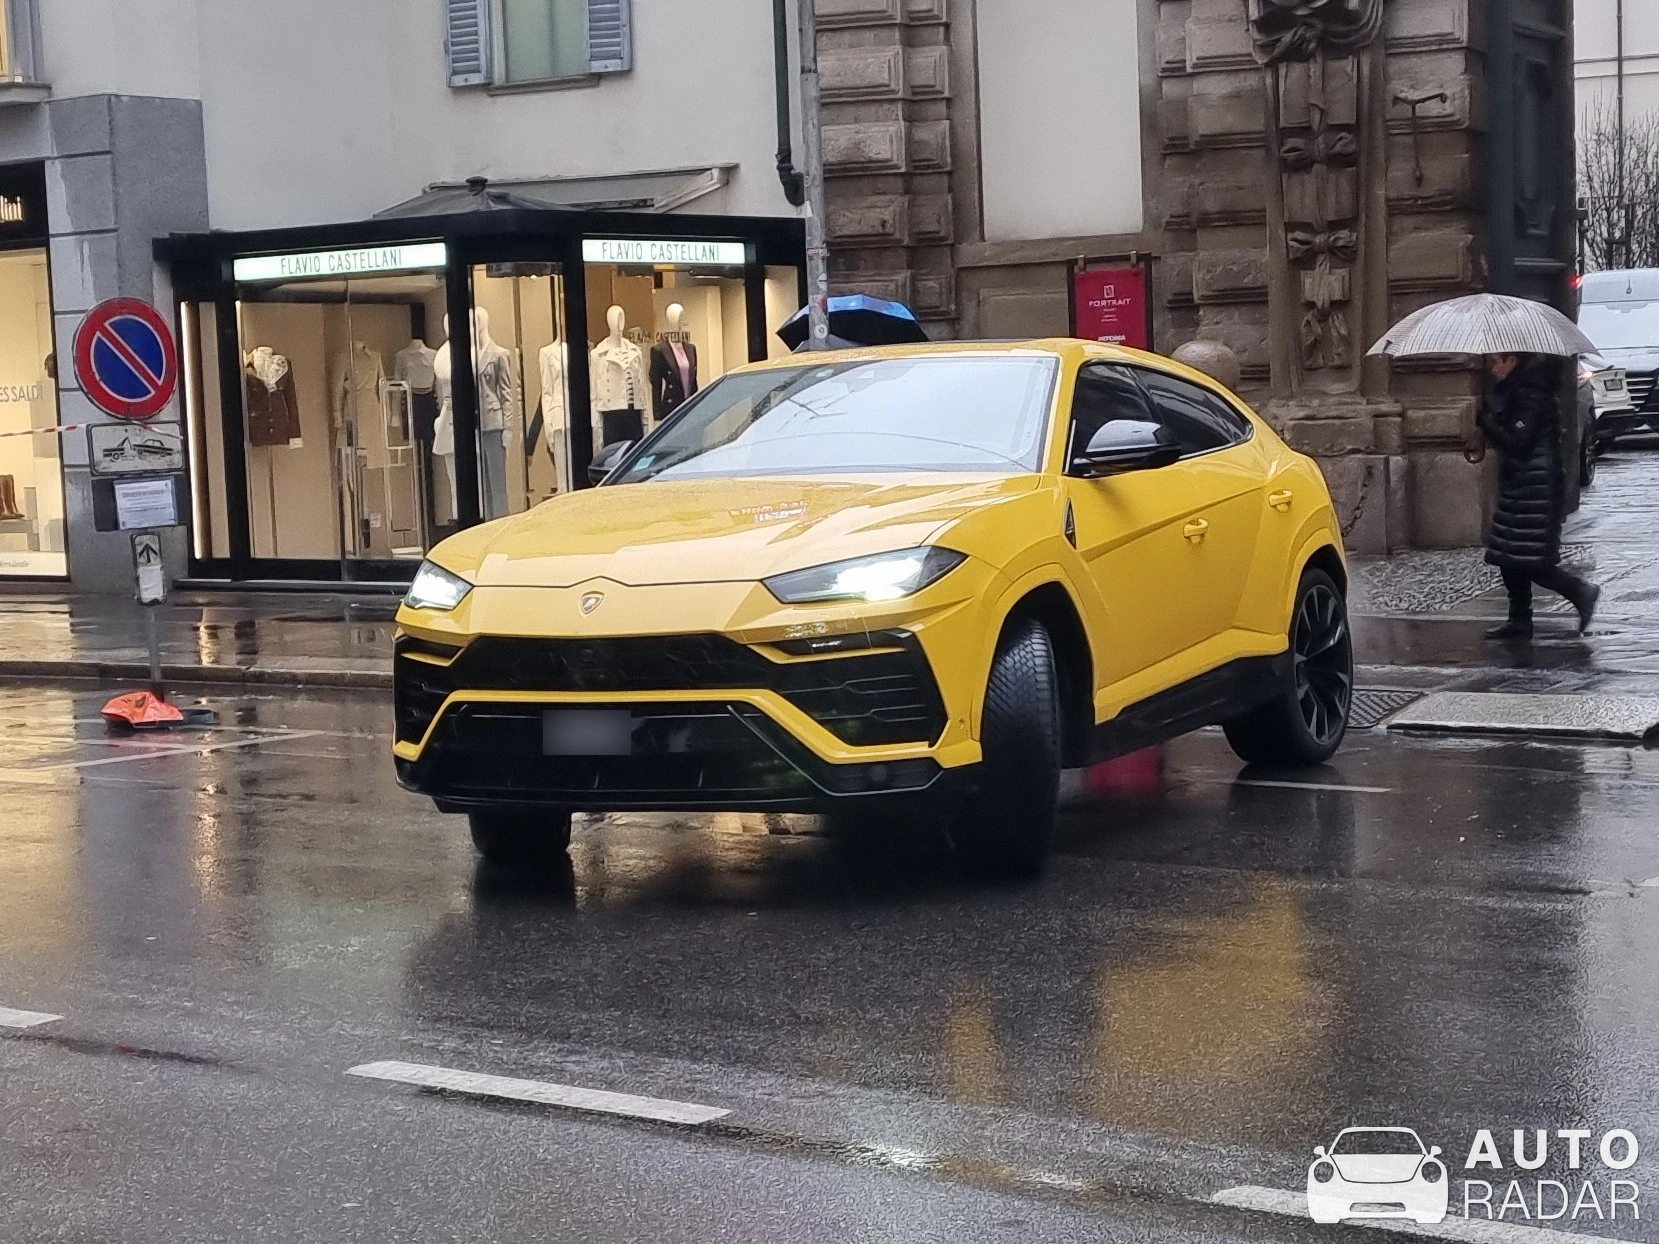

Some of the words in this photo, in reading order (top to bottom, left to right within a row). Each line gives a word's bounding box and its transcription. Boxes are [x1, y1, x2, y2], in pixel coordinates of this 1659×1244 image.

[281, 255, 321, 275] FLAVIO
[328, 249, 402, 272] CASTELLANI
[602, 242, 643, 260] FLAVIO
[650, 243, 720, 262] CASTELLANI
[1088, 298, 1131, 307] PORTRAIT
